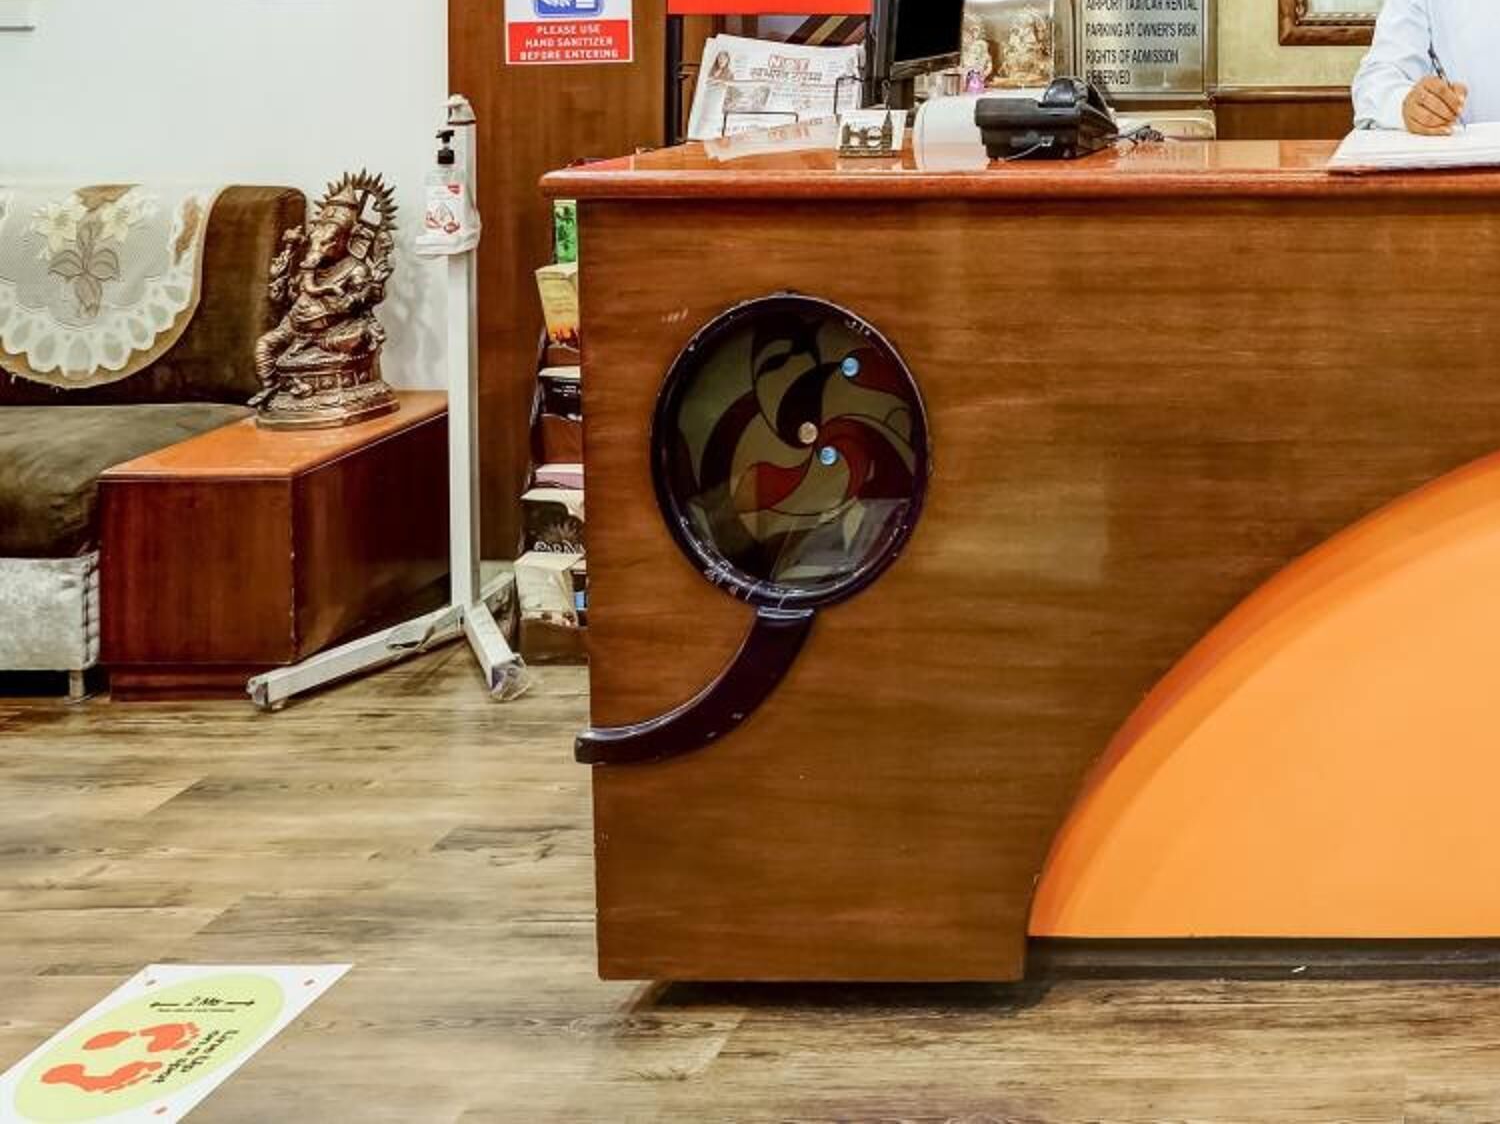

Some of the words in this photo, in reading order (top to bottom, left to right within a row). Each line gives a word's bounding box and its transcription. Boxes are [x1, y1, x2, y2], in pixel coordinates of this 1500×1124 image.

[536, 24, 577, 35] PLEASE
[579, 23, 602, 35] USE
[1085, 23, 1123, 37] PARKING
[1125, 23, 1136, 37] AT
[1137, 23, 1176, 37] OWNER'S
[1177, 23, 1198, 37] RISK
[525, 38, 555, 48] HAND
[556, 36, 613, 47] SANITIZER
[519, 51, 561, 61] BEFORE
[564, 49, 619, 60] ENTERING
[1085, 49, 1117, 64] RIGHTS
[1119, 49, 1130, 64] OF
[1131, 49, 1179, 64] ADMISSION
[1085, 70, 1131, 85] RESERVED
